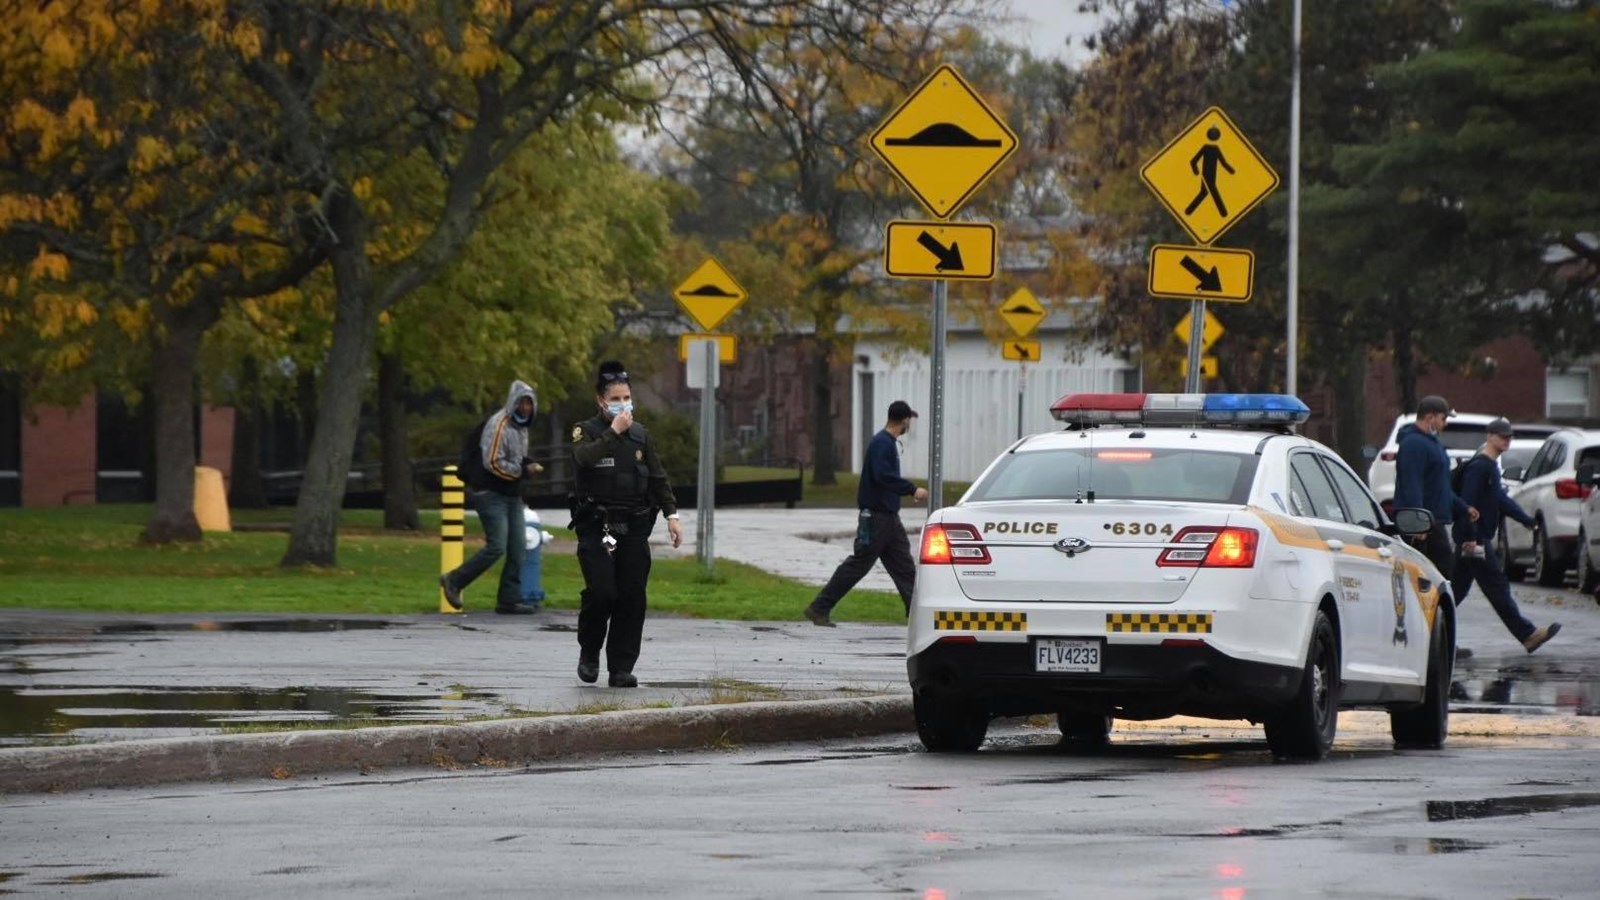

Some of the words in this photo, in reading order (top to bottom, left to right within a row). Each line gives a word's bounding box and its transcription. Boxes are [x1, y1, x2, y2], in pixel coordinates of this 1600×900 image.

[983, 522, 1058, 534] POLICE
[1113, 522, 1173, 536] 6304
[1062, 538, 1081, 547] Ford
[1039, 647, 1098, 664] FLV4233
